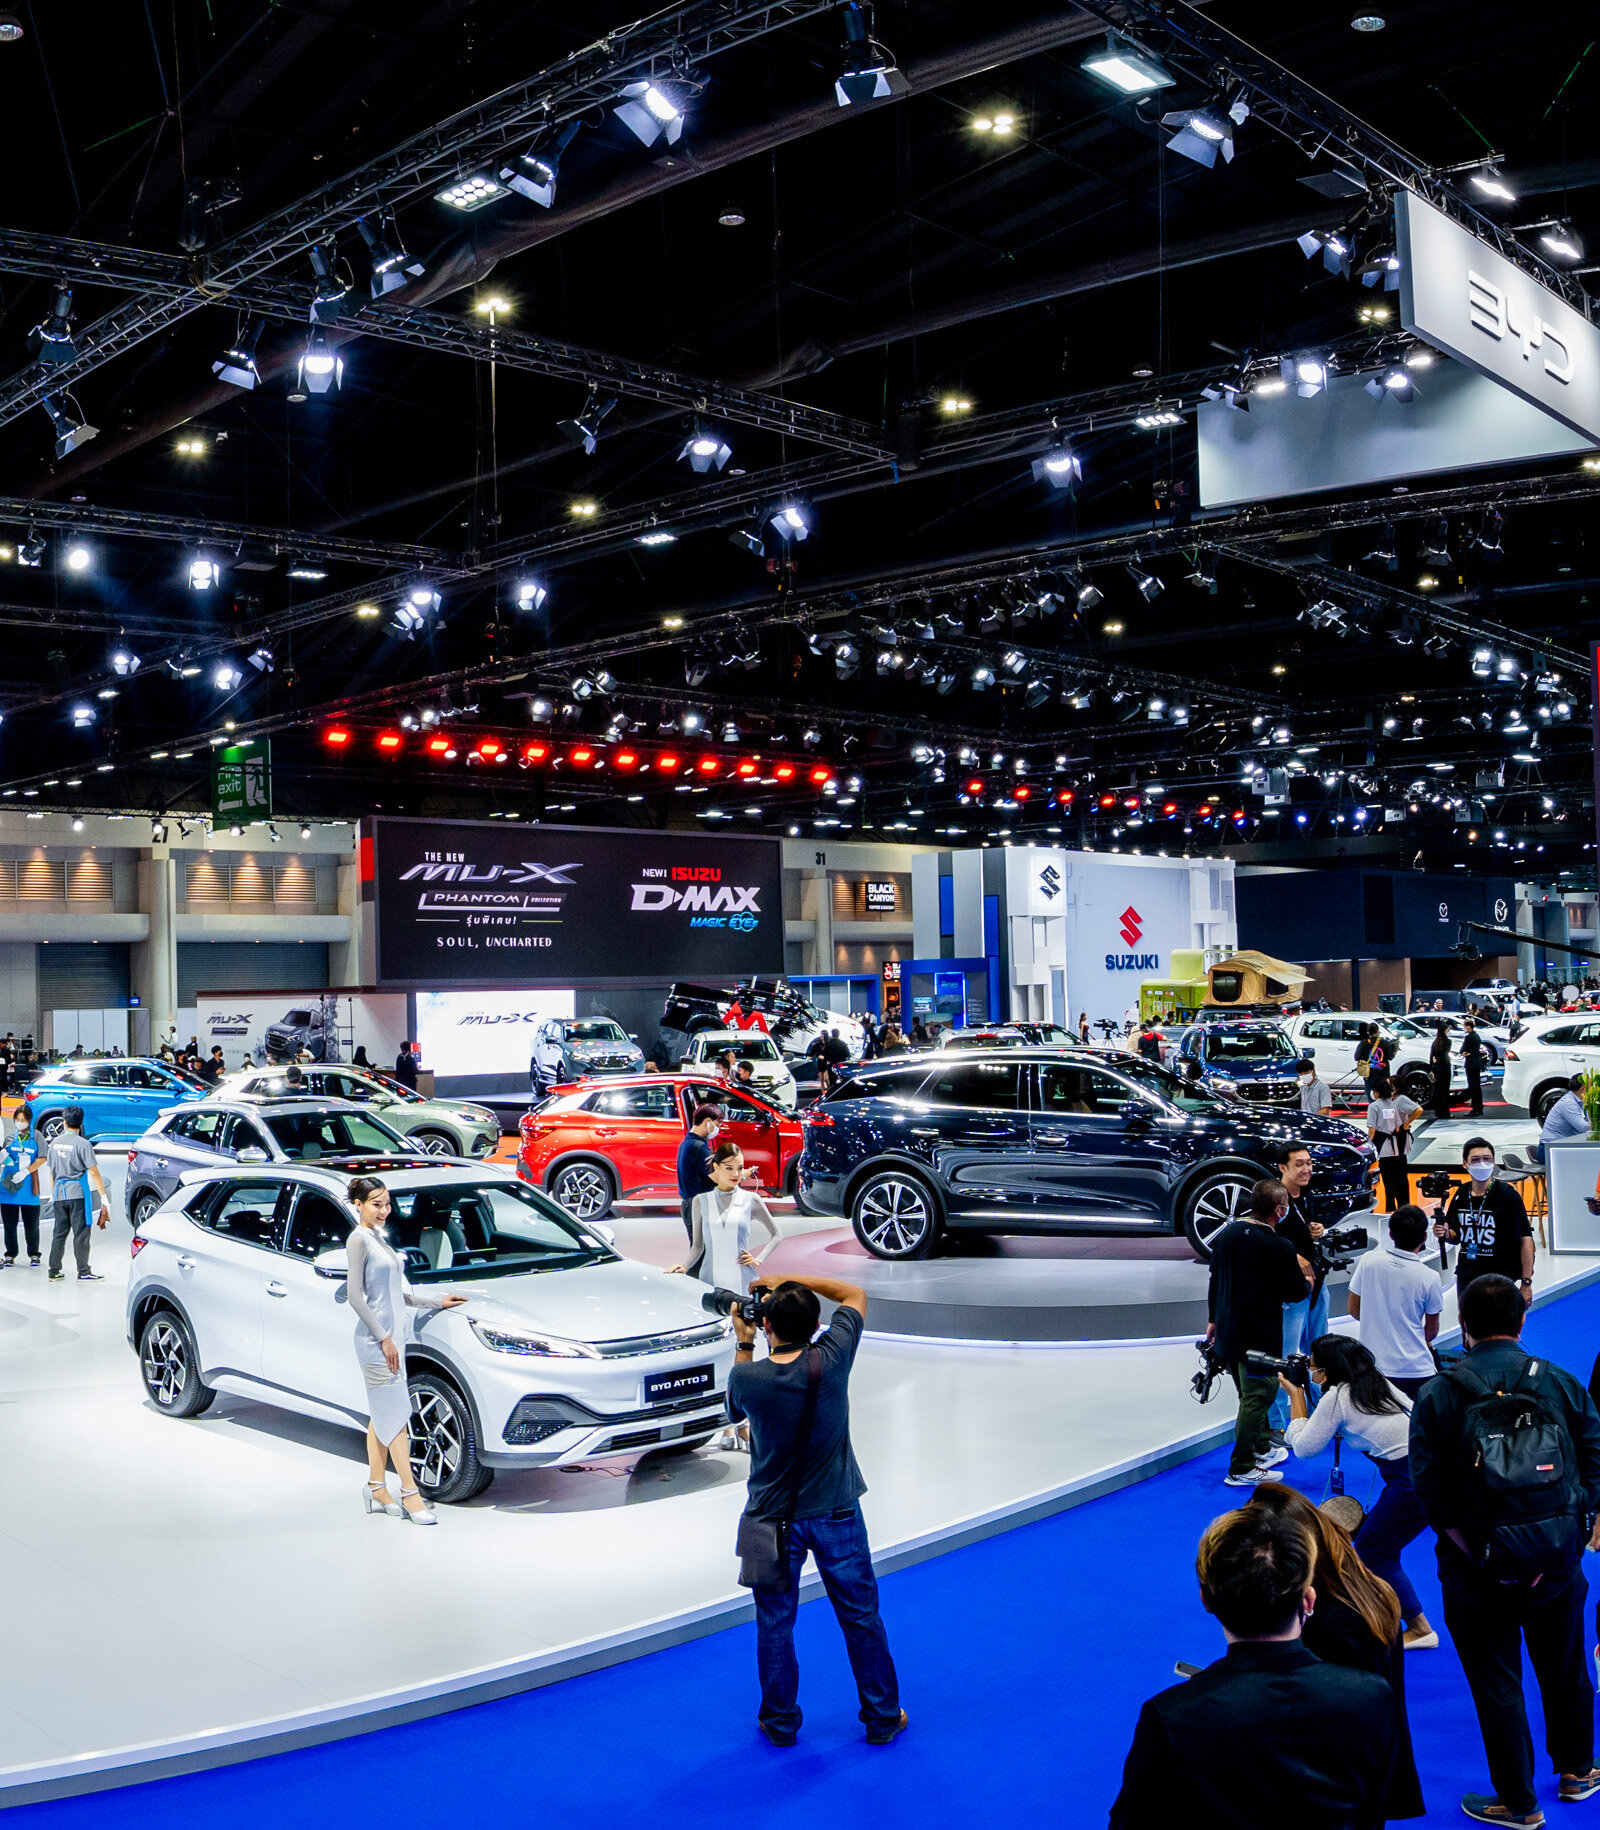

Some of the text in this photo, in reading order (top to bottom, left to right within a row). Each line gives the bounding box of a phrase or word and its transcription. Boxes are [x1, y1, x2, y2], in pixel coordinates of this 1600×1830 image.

[1469, 270, 1574, 385] BYD
[218, 779, 242, 794] exit
[425, 851, 465, 862] THE NEW
[815, 852, 826, 865] 31
[642, 866, 721, 881] NEW! ISUZU
[868, 883, 895, 894] BLACK
[433, 893, 520, 903] PHANTOM
[868, 894, 895, 902] CANYON
[690, 916, 727, 927] MAGIC
[437, 936, 553, 949] SOUL, UNCHARTED
[1105, 953, 1159, 970] SUZUKI
[650, 1374, 708, 1392] BYD ATTO 3
